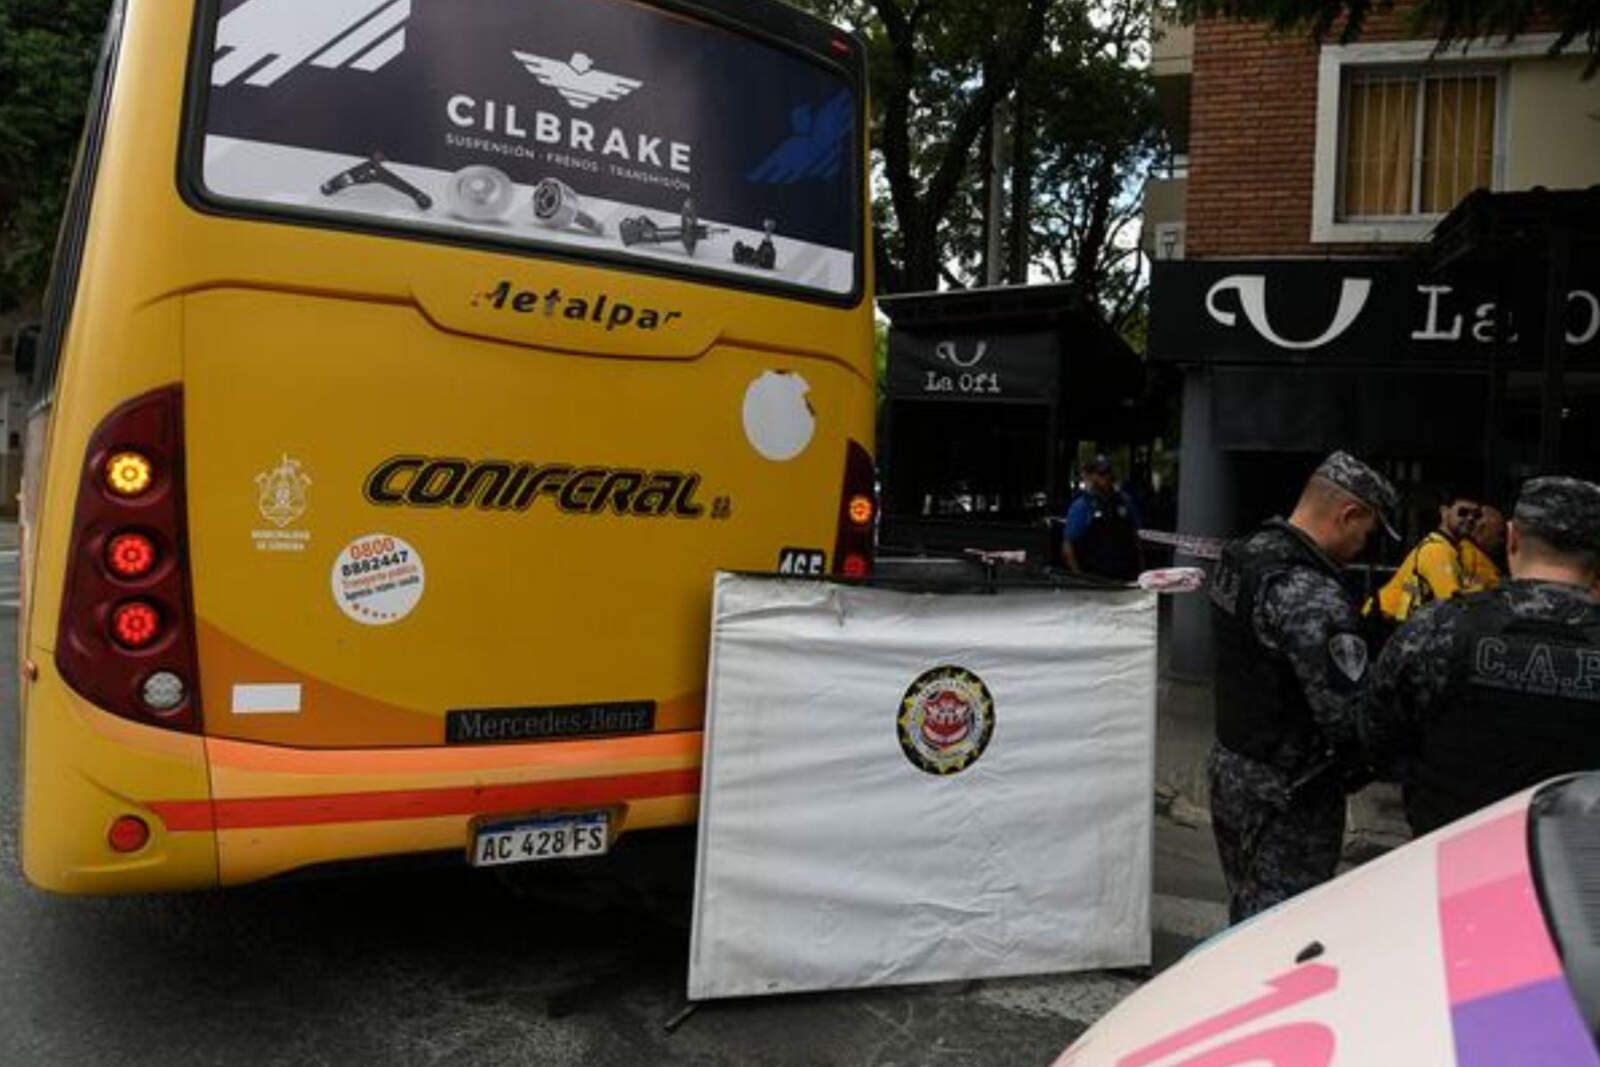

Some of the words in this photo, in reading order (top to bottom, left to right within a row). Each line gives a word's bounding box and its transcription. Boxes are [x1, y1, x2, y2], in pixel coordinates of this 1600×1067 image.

[447, 94, 691, 173] CILBRAKE
[445, 133, 534, 160] SUSPENSIÓN
[546, 153, 599, 173] FRENOS
[924, 370, 953, 391] La
[959, 372, 1001, 393] Ofi
[342, 550, 409, 577] 8882447
[350, 537, 395, 560] 0800
[457, 706, 648, 738] Mercedes-Benz
[482, 835, 513, 862] AC
[522, 829, 566, 856] 428
[572, 826, 604, 851] FS
